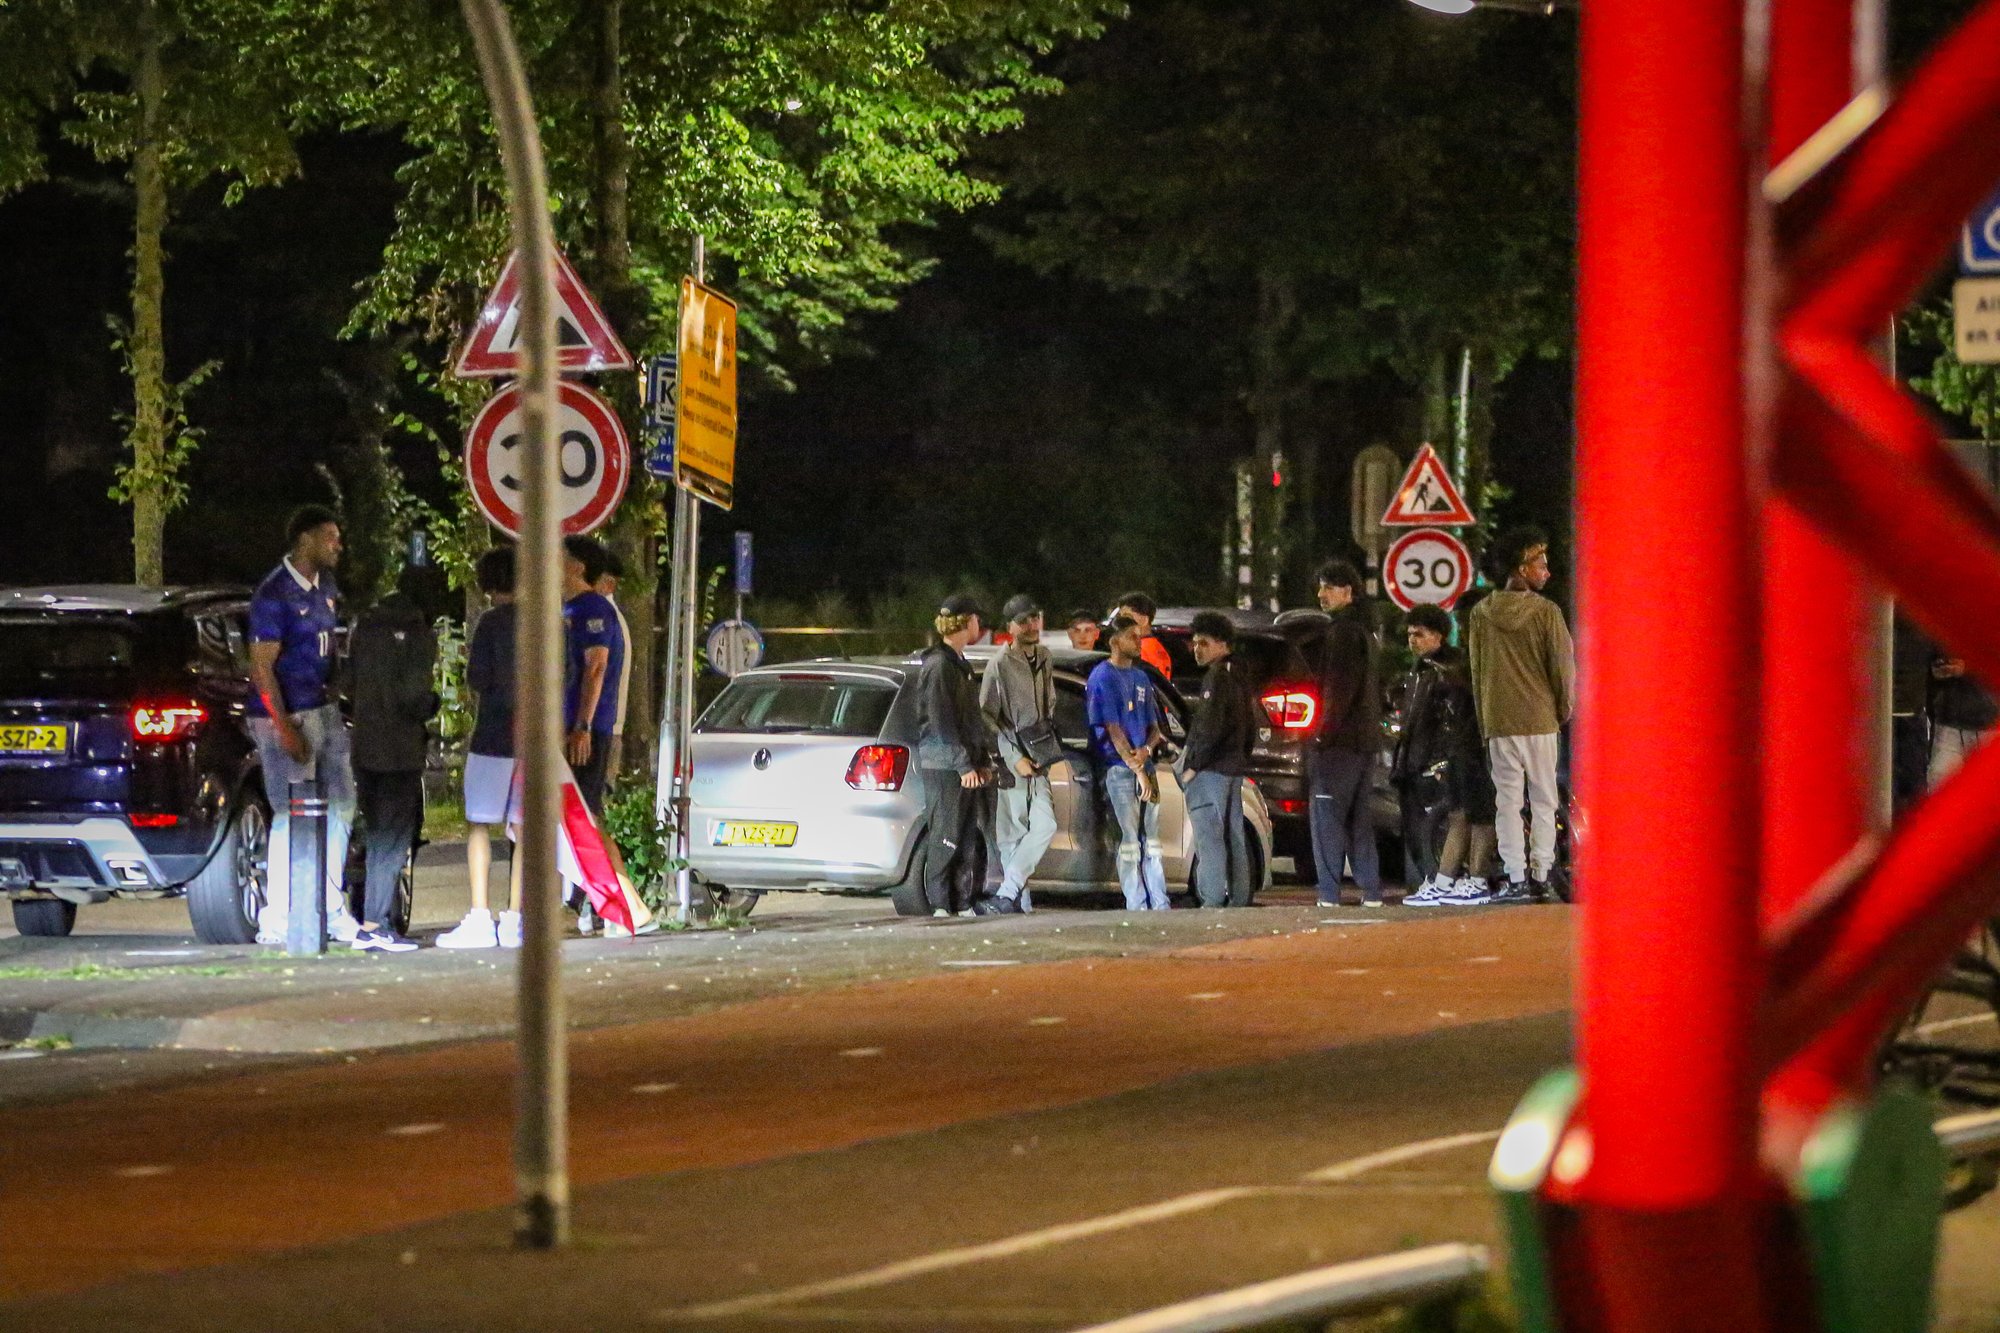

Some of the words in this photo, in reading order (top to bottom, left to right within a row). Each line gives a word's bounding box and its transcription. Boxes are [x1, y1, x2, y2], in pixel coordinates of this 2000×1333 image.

[661, 381, 676, 405] K
[500, 430, 597, 488] 0
[1402, 558, 1455, 589] 30
[730, 827, 785, 841] 1XZS-21
